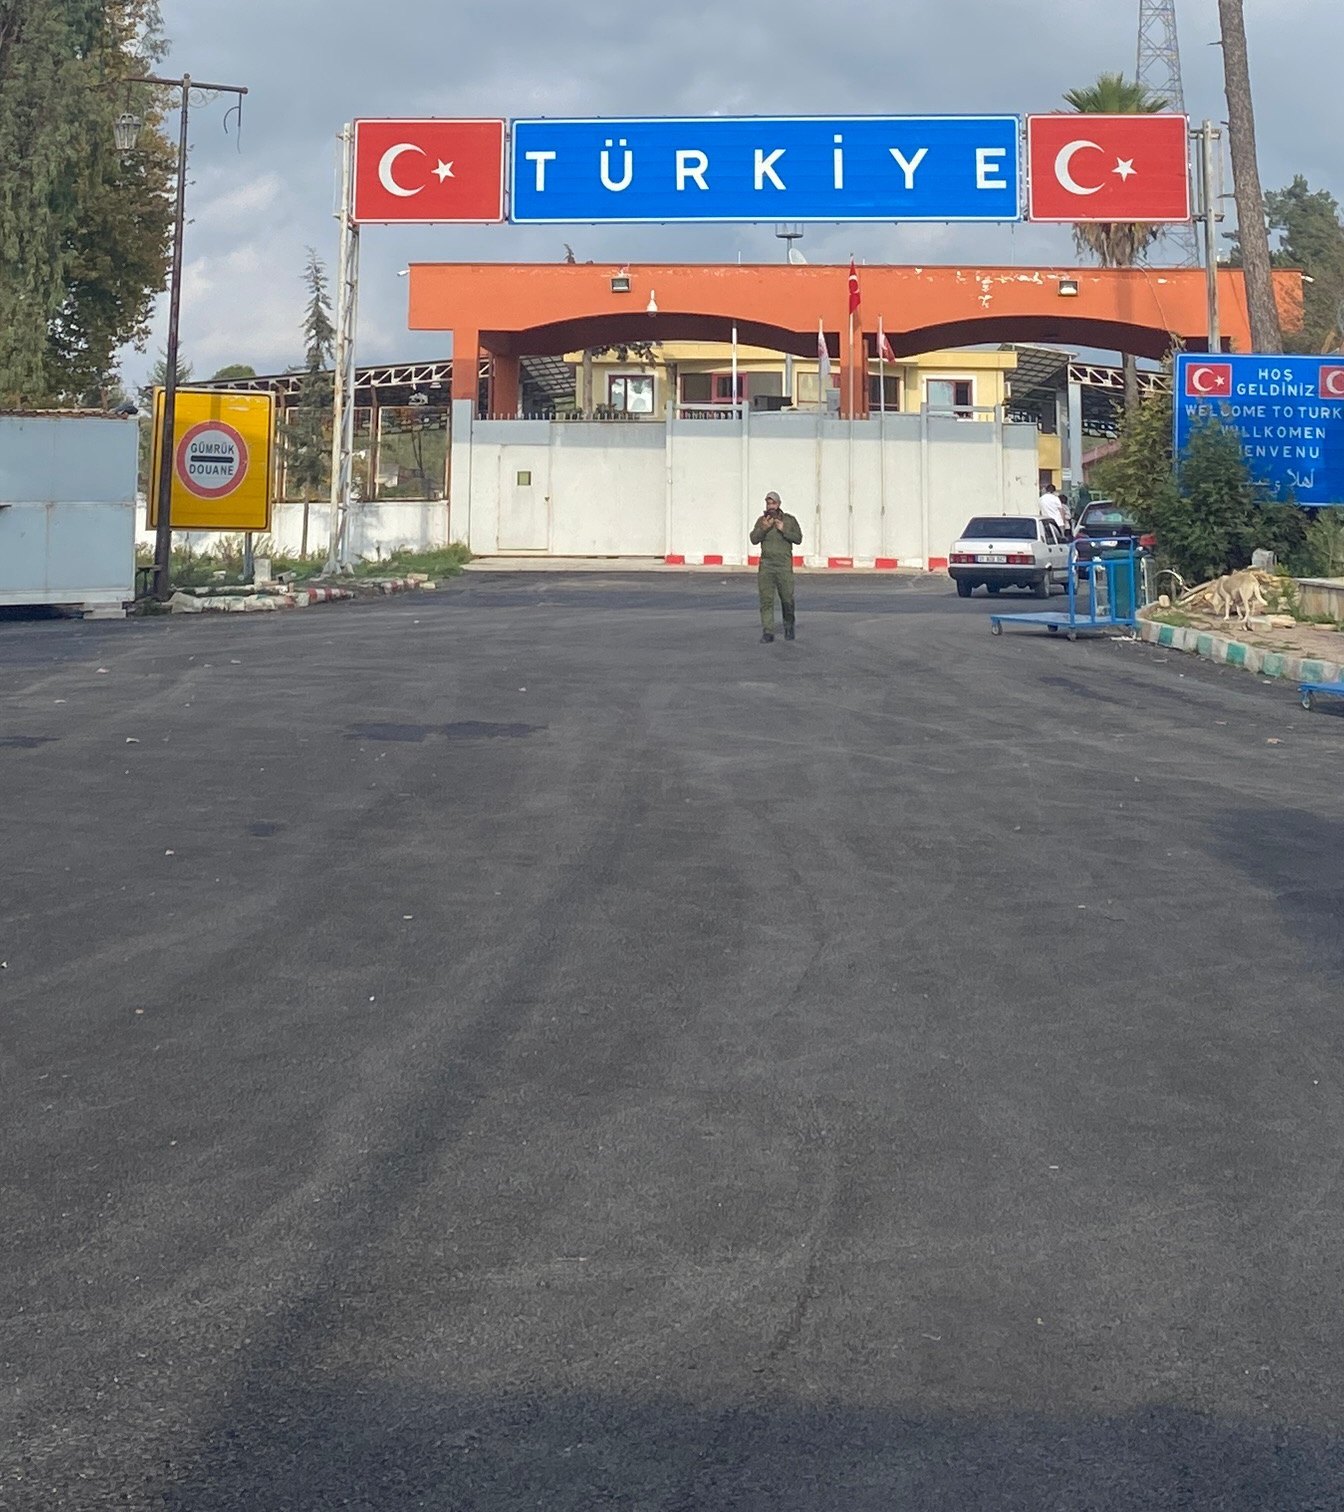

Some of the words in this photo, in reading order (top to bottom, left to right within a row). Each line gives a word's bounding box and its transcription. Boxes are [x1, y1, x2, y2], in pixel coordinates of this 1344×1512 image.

[524, 134, 1008, 193] TÜRKİYE
[1258, 368, 1294, 382] HOŞ
[1236, 382, 1316, 397] GELDİNİZ
[1272, 406, 1294, 418] TO
[190, 441, 234, 454] GÜMRÜK
[189, 464, 234, 476] DOUANE
